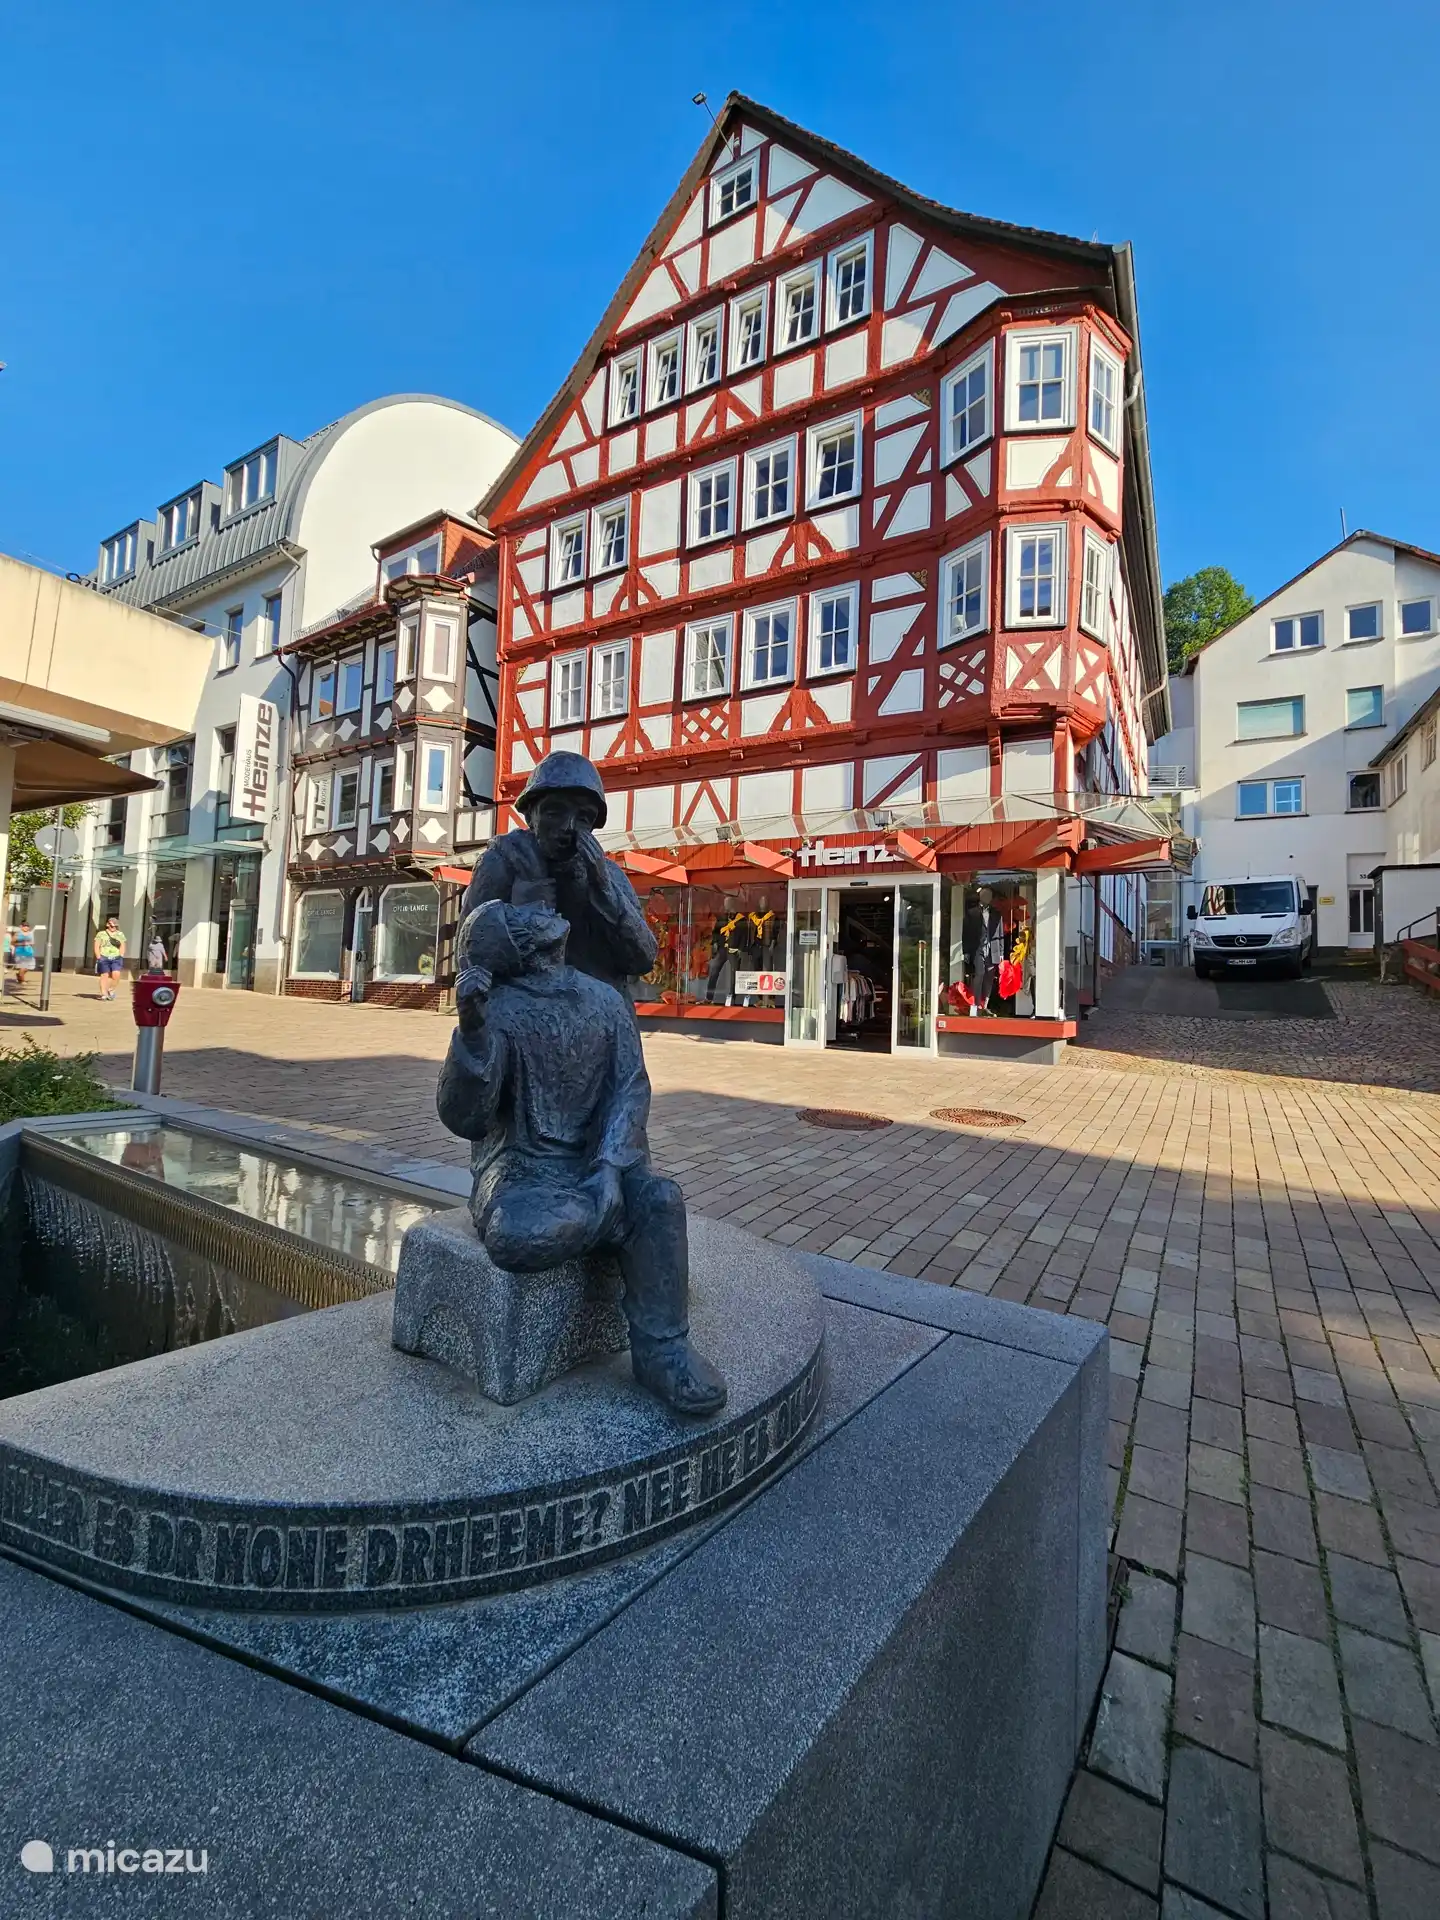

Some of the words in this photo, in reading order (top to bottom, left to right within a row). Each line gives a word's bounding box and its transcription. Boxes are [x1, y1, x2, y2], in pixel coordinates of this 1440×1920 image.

[242, 702, 273, 817] Heinze
[243, 749, 253, 788] MODEHAUS
[796, 840, 905, 868] Heinz
[410, 904, 429, 912] LANGE
[146, 1512, 203, 1582] DR
[364, 1488, 612, 1589] DRHEEME?
[622, 1456, 691, 1535] NEE
